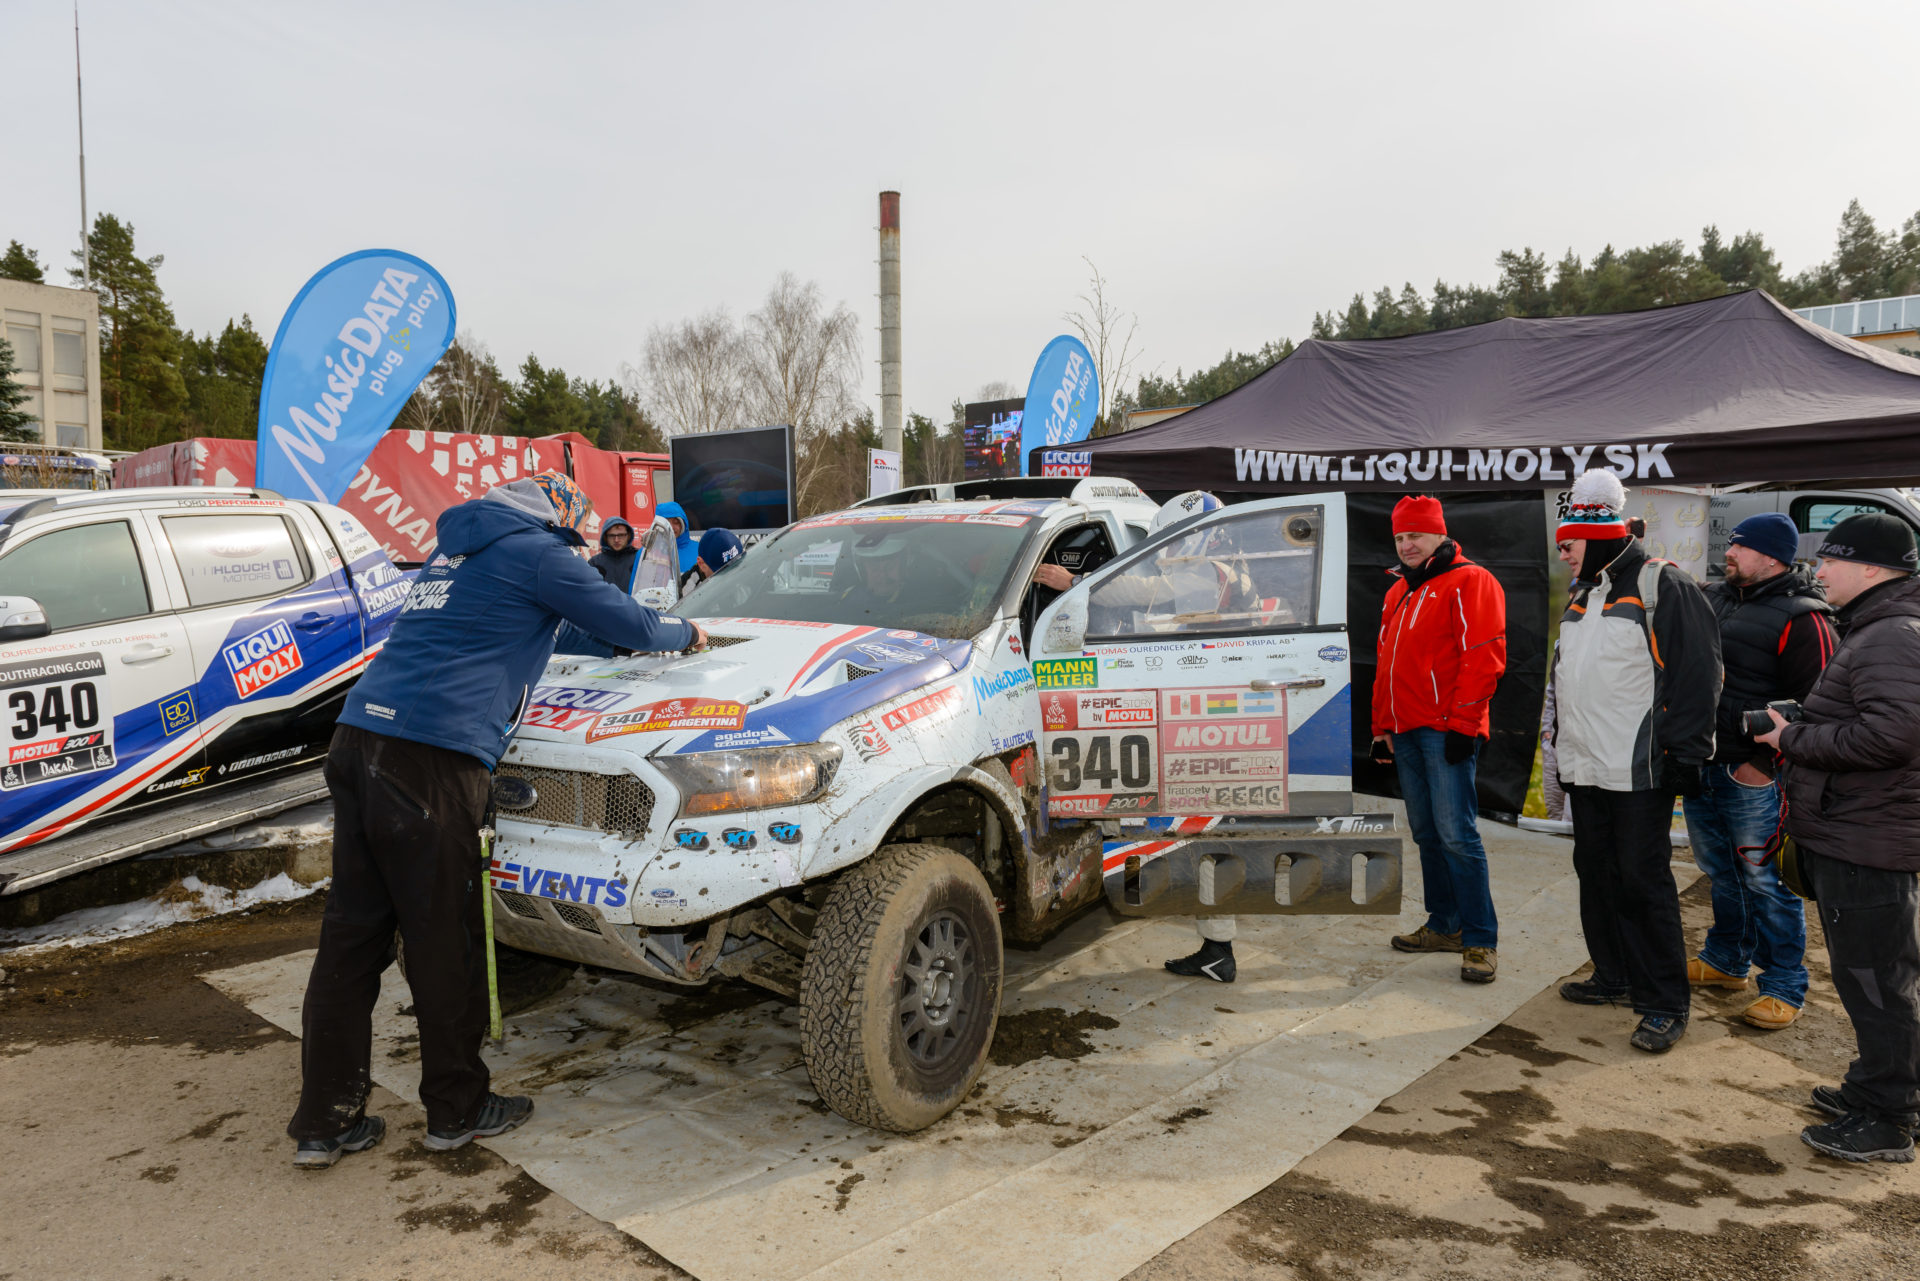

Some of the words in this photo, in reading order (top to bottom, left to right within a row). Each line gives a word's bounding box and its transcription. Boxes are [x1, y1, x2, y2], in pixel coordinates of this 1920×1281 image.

[369, 350, 403, 396] plug
[407, 282, 439, 329] play
[271, 267, 419, 504] MusicDATA
[1044, 452, 1091, 465] LIQUI
[1235, 442, 1675, 485] WWW.LIQUI-MOLYSK
[1044, 465, 1090, 477] MOLY
[207, 499, 286, 507] PERFORMANCE
[1062, 553, 1080, 563] OMP
[213, 562, 271, 576] HLOUCH
[223, 572, 272, 583] MOTORS
[91, 637, 122, 647] DAVID
[125, 633, 160, 643] KRIPAL
[228, 623, 291, 671] LIQUI
[1097, 647, 1128, 655] TOMAS
[1129, 644, 1186, 653] OUREDNICEK
[1217, 640, 1245, 648] DAVID
[1246, 639, 1277, 647] KRIPAL
[237, 645, 297, 695] MOLY
[1036, 660, 1094, 674] MANN
[1037, 673, 1095, 687] FILTER
[972, 667, 1033, 716] MusicDATA
[8, 681, 100, 741] 340
[690, 704, 741, 717] 2018
[1093, 713, 1102, 722] by
[1107, 711, 1152, 721] MOTUL
[604, 712, 647, 727] 340
[591, 724, 625, 739] PERU
[622, 720, 670, 734] BOLIVIA
[668, 717, 738, 728] ARGENTINA
[714, 730, 769, 741] agados
[1173, 724, 1272, 747] MOTUL
[11, 743, 60, 761] MOTUL
[63, 732, 103, 750] 300V
[39, 756, 78, 777] DAKAR
[1052, 735, 1151, 791] 340
[1048, 798, 1102, 812] MOTUL
[1109, 795, 1156, 809] 300V
[1169, 794, 1210, 810] sport
[772, 824, 801, 840] XT
[1315, 816, 1384, 833] XTline
[678, 831, 708, 846] XT
[725, 830, 756, 846] XT
